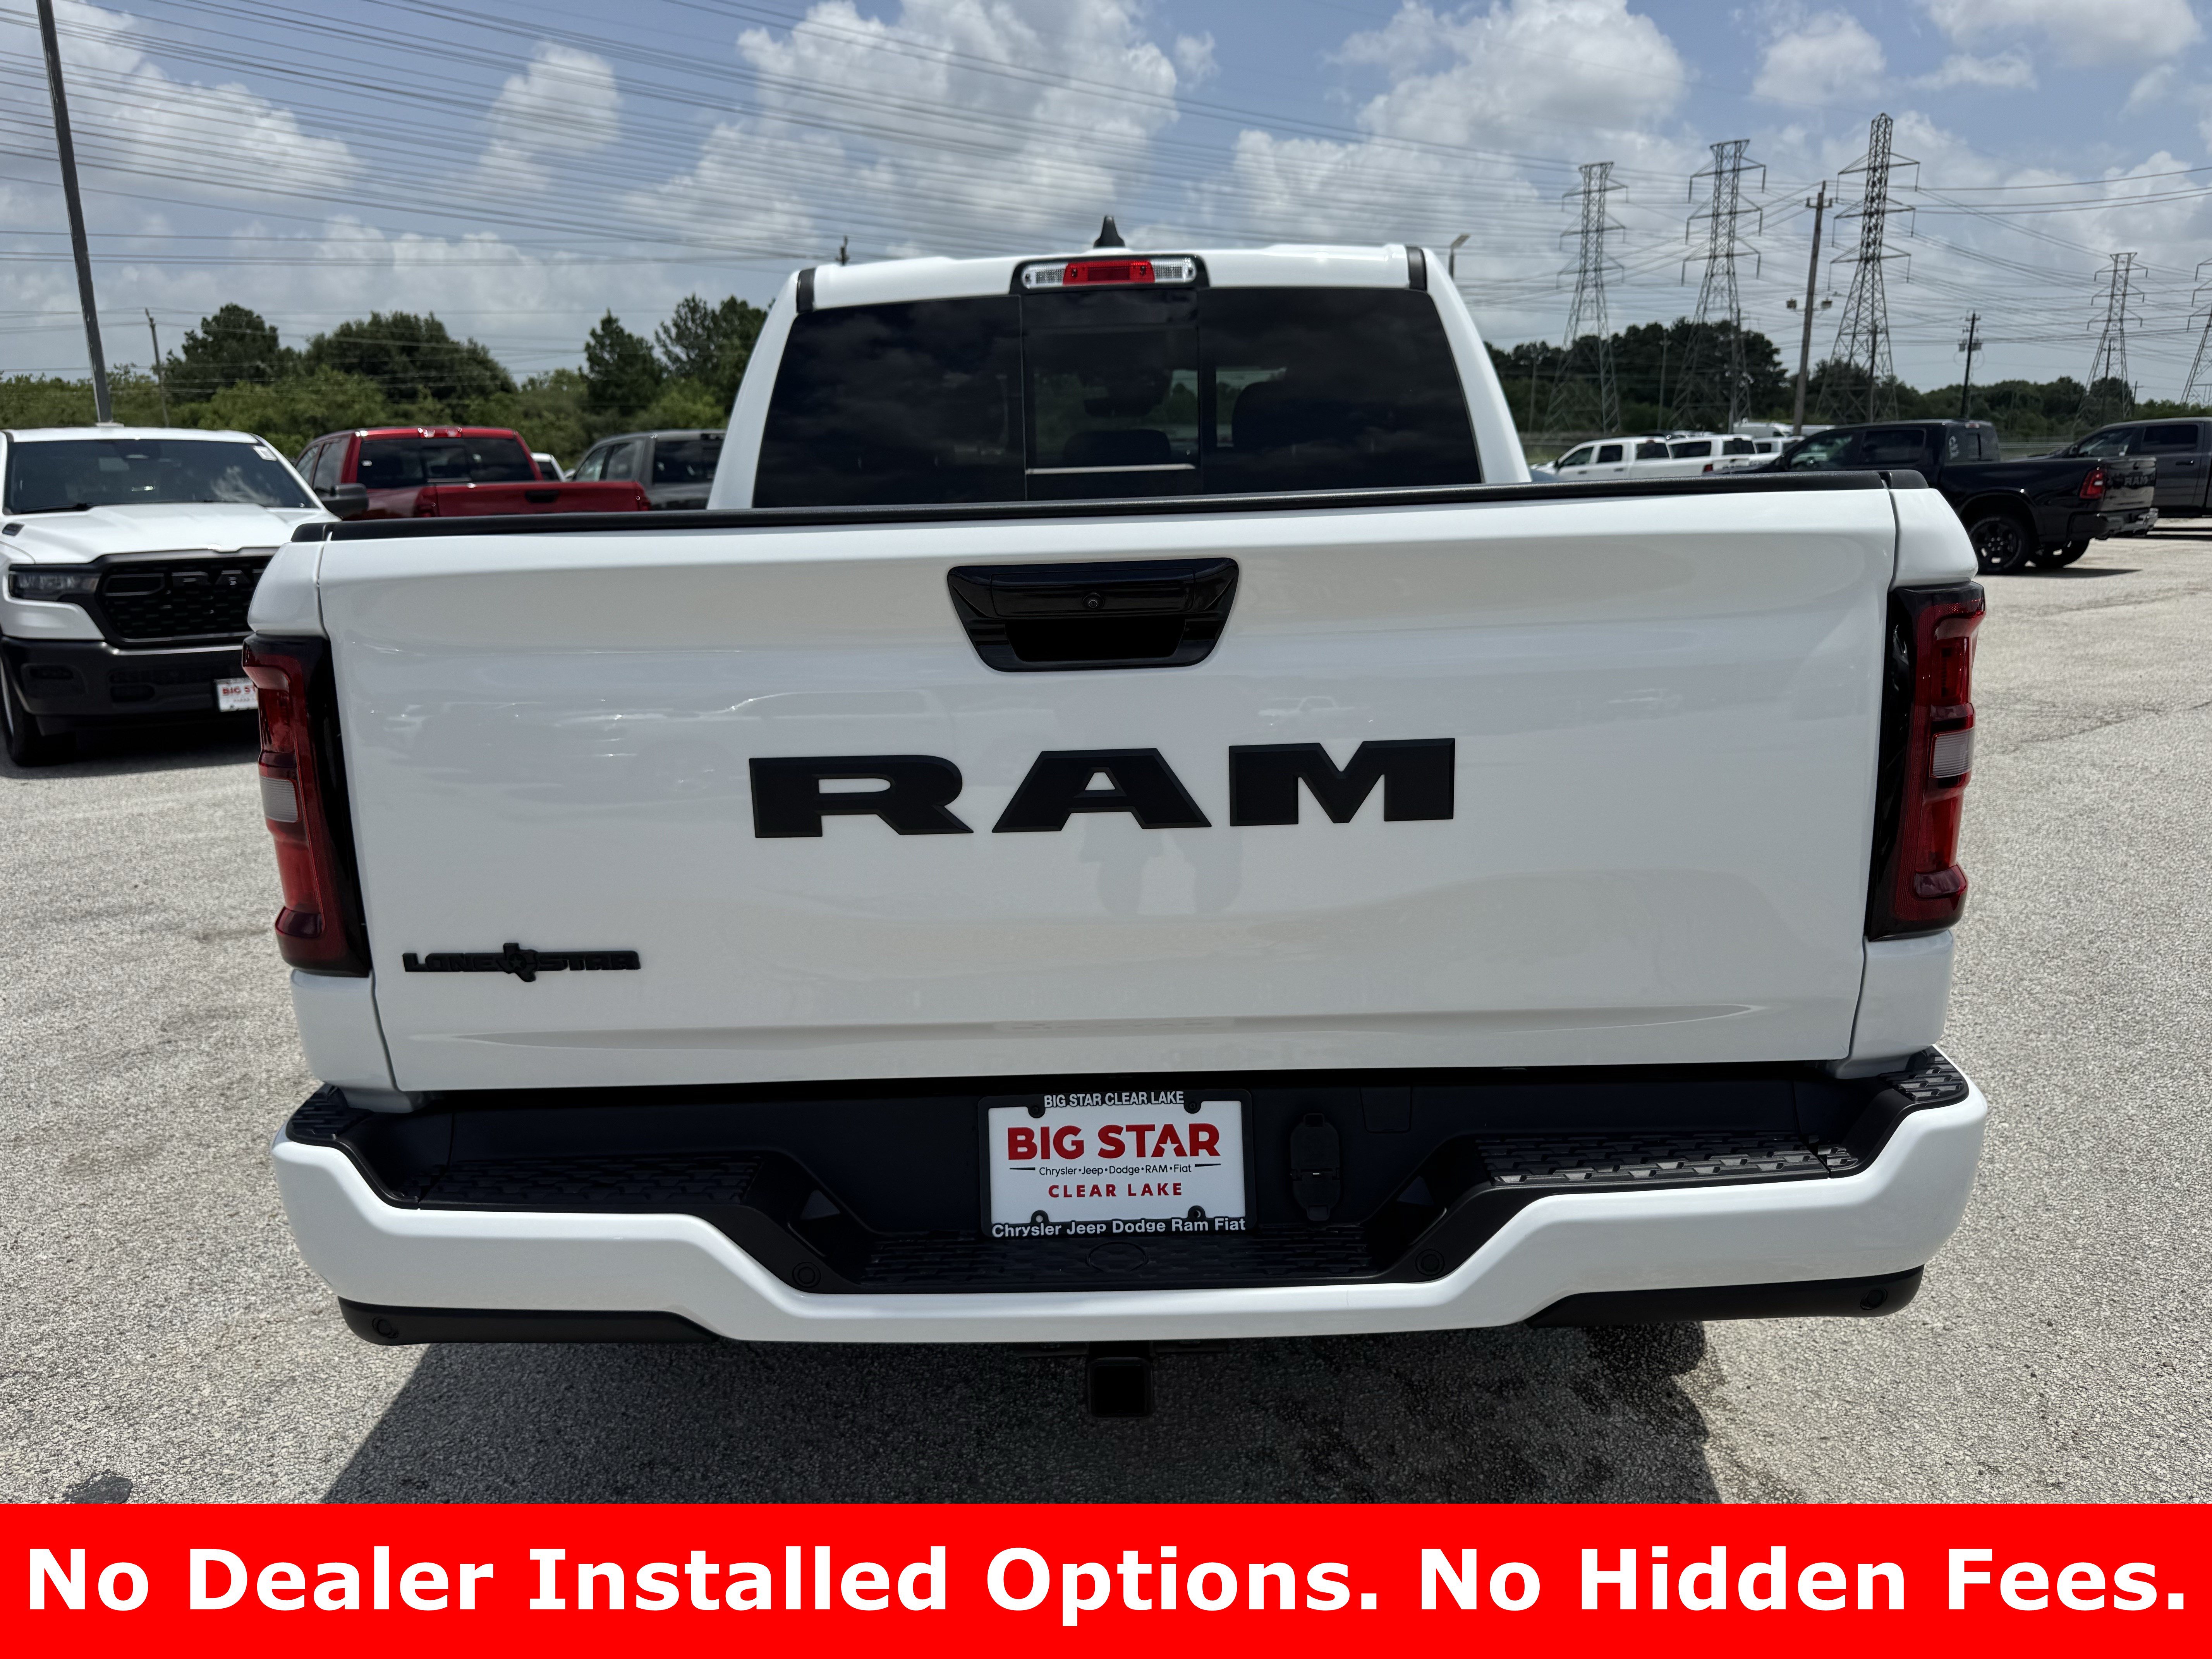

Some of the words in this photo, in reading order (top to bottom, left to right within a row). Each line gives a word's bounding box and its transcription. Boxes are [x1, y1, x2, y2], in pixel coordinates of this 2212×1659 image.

[2124, 476, 2149, 486] RAM
[222, 687, 241, 695] BIG
[748, 738, 1456, 839] RAM
[536, 950, 642, 971] STAR
[1044, 1094, 1066, 1108] BIG
[1069, 1093, 1102, 1107] STAR
[1105, 1092, 1148, 1106] CLEAR
[1151, 1091, 1185, 1104] LAKE
[1008, 1125, 1084, 1161] BIG
[1097, 1123, 1221, 1159] STAR
[1048, 1184, 1117, 1198] CLEAR
[1128, 1182, 1182, 1197] LAKE
[992, 1222, 1062, 1238] Chrysler
[1066, 1221, 1106, 1235] Jeep
[1112, 1219, 1166, 1233] Dodge
[1171, 1219, 1209, 1231] Ram
[1214, 1218, 1246, 1231] Fiat
